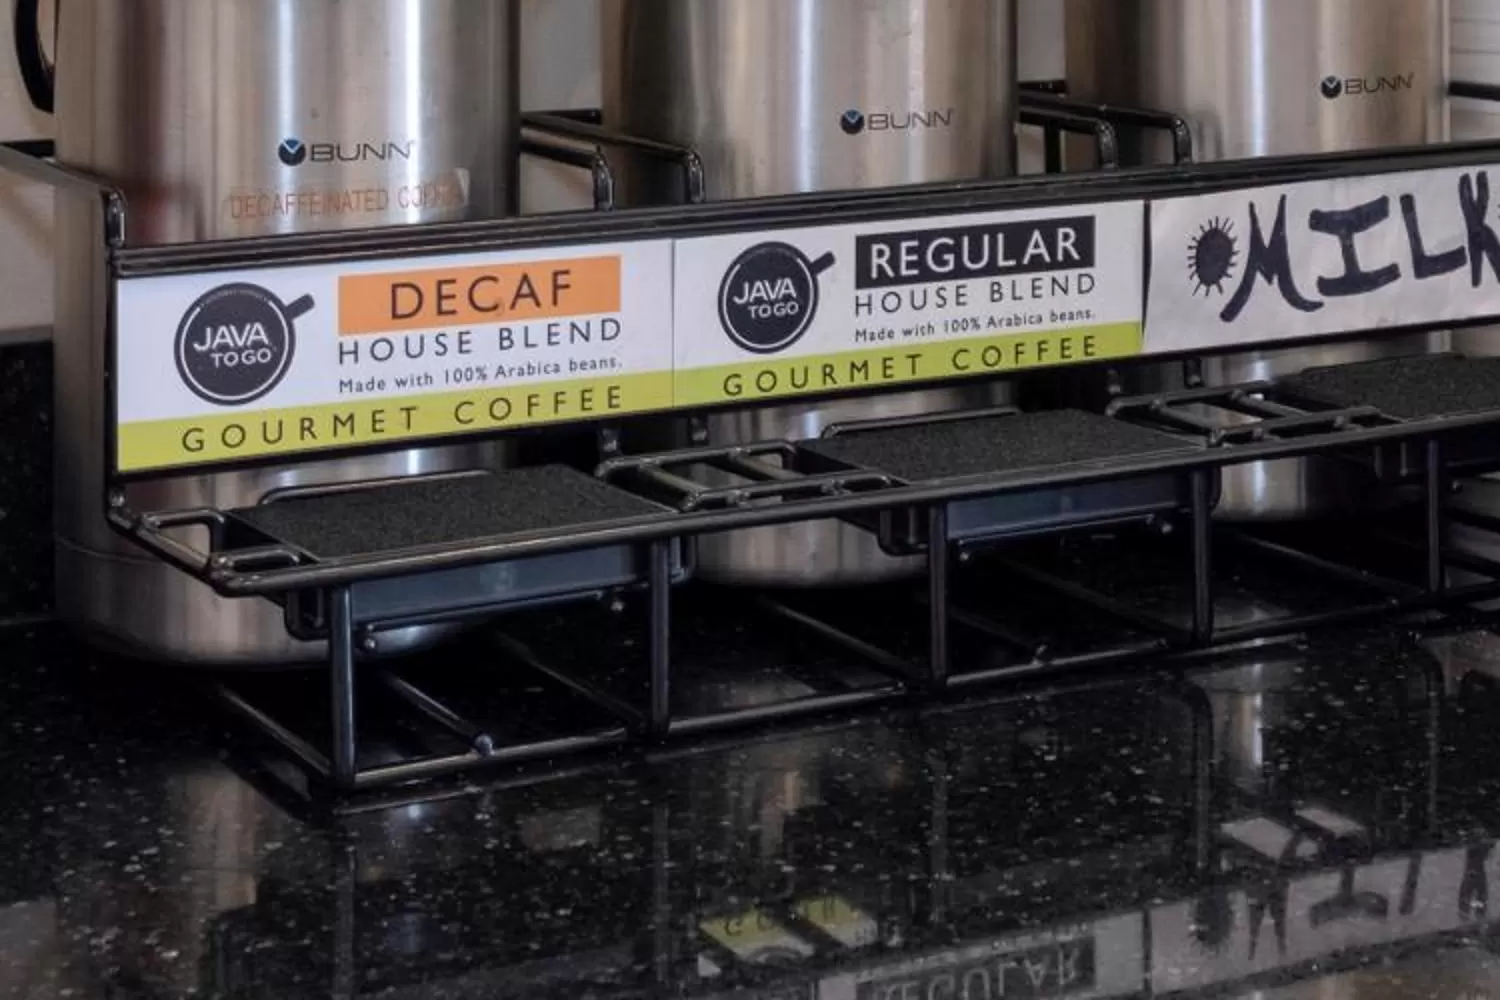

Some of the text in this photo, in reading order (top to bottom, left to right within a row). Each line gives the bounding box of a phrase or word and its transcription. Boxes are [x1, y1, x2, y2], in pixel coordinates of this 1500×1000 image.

[1344, 73, 1414, 95] BUNN
[868, 108, 954, 131] BUNN
[309, 141, 413, 162] BUNN
[870, 226, 1081, 280] REGULAR
[390, 269, 572, 320] DECAF
[733, 277, 798, 305] JAVA
[855, 273, 1096, 317] HOUSE BLEND
[193, 321, 269, 352] JAVA
[338, 317, 621, 365] HOUSE BLEND
[855, 308, 1095, 342] Made with 100% Arabica beans.
[338, 355, 623, 394] Made with 100% Arabica beans.
[723, 335, 1097, 397] GOURMET COFFEE
[182, 386, 623, 453] GOURMET COFFEE
